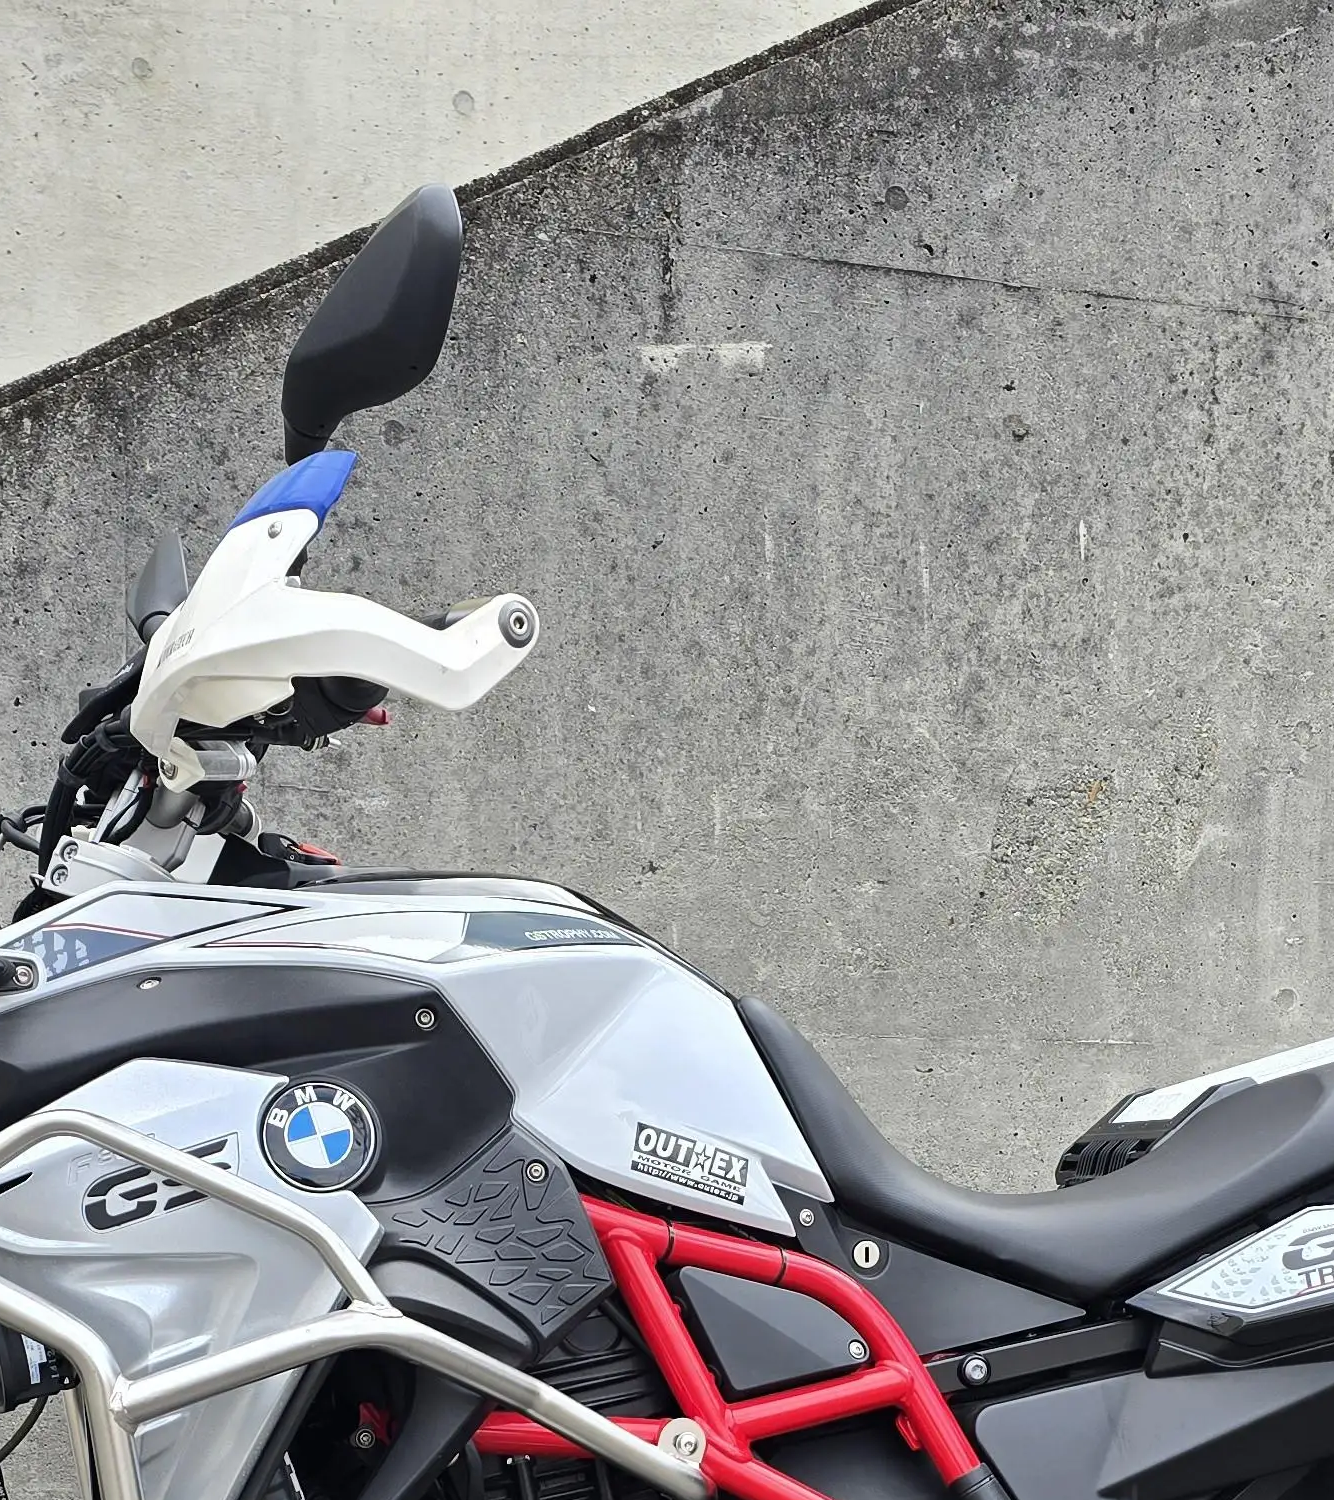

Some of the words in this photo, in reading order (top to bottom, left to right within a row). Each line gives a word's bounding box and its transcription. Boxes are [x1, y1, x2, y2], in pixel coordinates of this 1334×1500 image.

[267, 1085, 357, 1129] BMW
[637, 1154, 692, 1176] MOTOR
[700, 1174, 742, 1194] GAME
